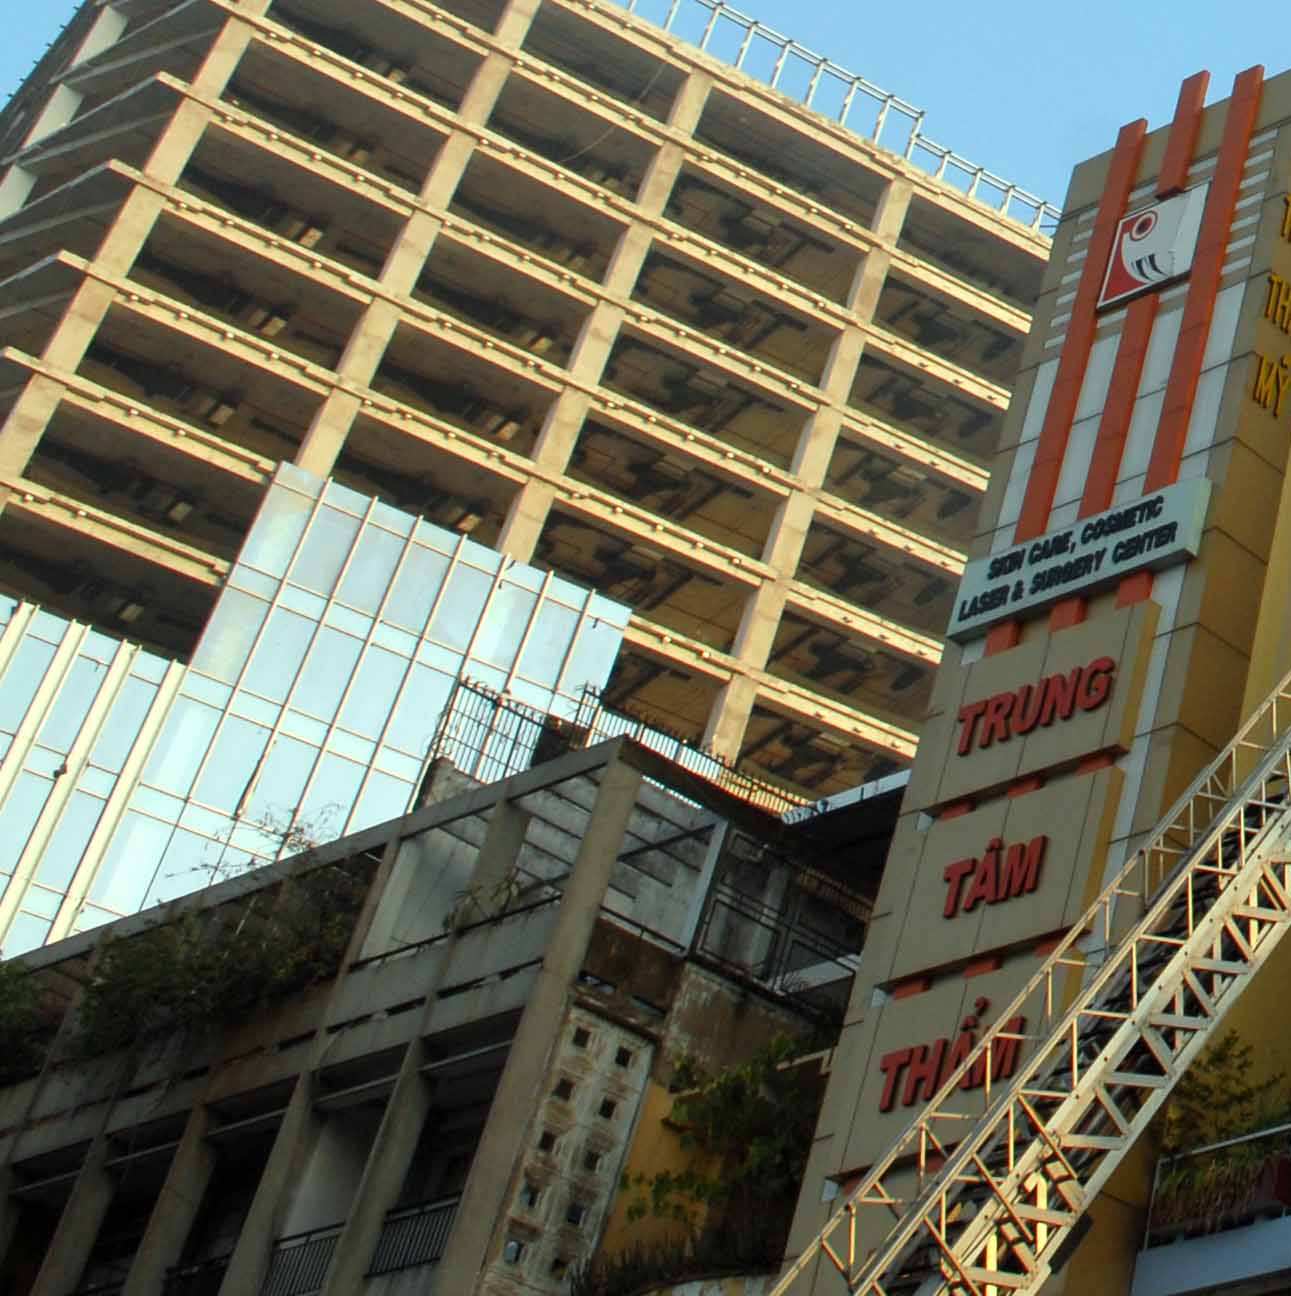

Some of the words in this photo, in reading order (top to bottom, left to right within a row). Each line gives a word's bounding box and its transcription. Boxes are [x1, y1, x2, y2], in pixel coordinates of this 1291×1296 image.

[957, 585, 1010, 622] LASER
[1029, 548, 1108, 595] SURGERY
[1112, 521, 1179, 564] CENTER
[987, 547, 1027, 580] SKIN
[1080, 495, 1165, 545] COSMETIC
[956, 656, 1116, 757] TRUNG
[942, 834, 1050, 918] TÂM
